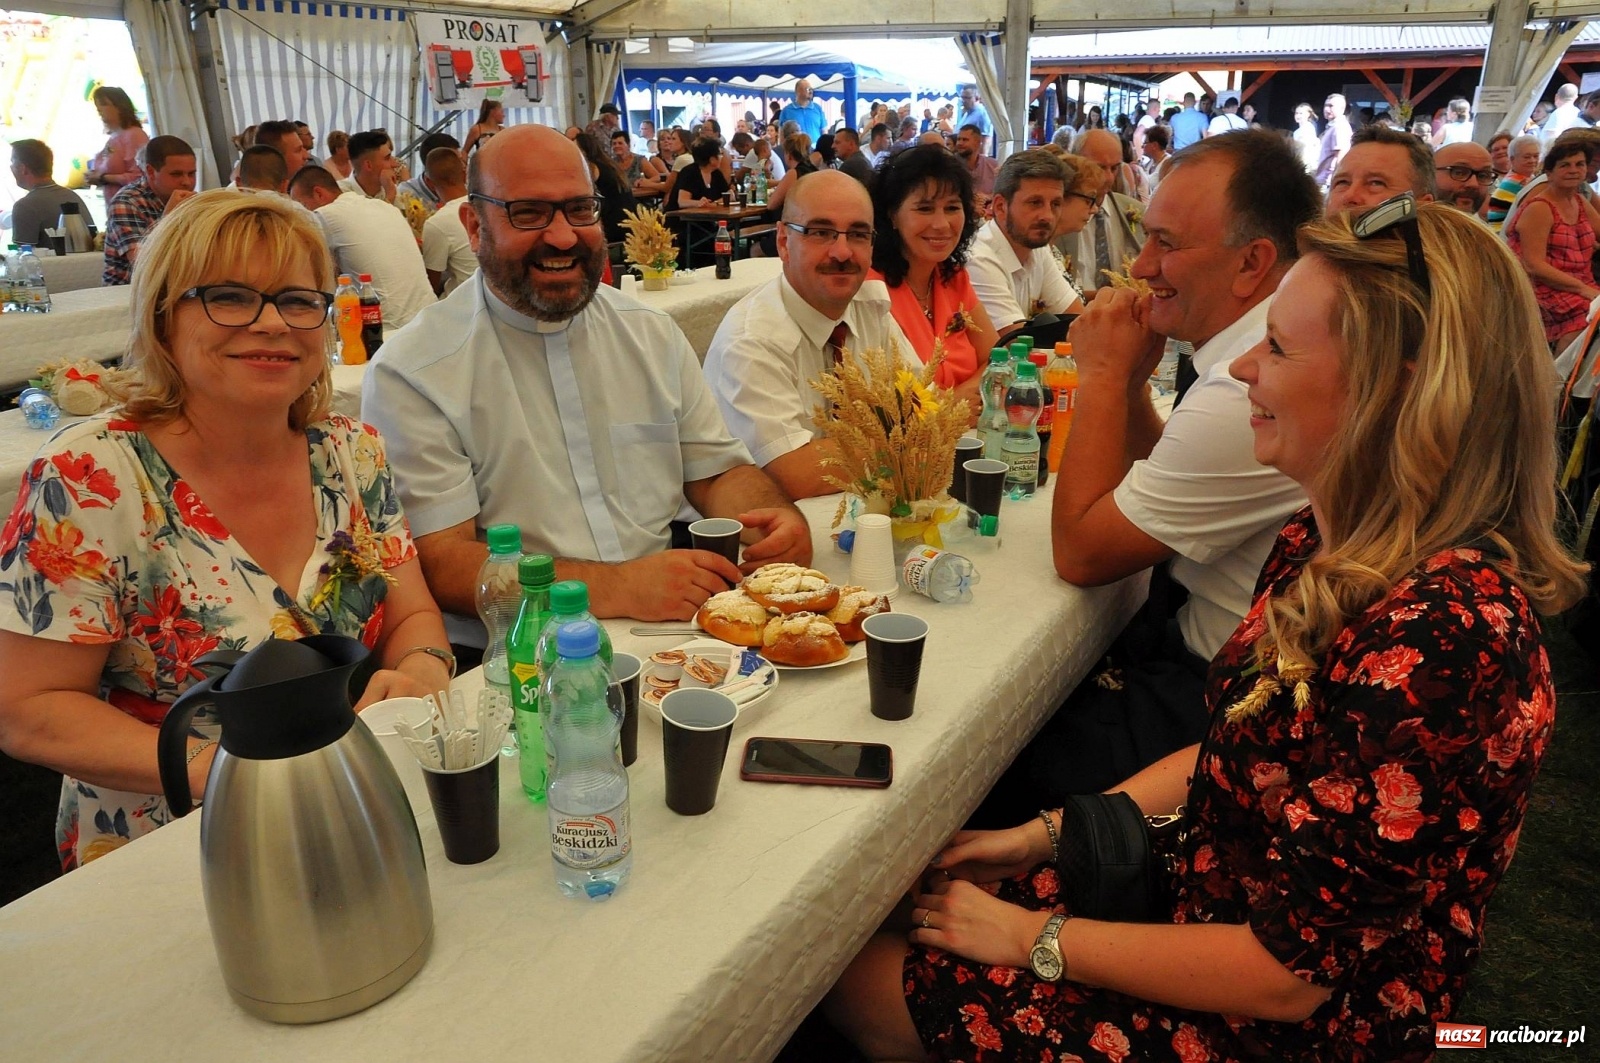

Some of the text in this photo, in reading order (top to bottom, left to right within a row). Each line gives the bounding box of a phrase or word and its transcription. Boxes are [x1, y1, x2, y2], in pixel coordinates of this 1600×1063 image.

[443, 18, 519, 43] PROSAT
[482, 51, 491, 66] 5
[556, 825, 609, 837] Kuracjusz
[552, 833, 618, 849] Beskidzki
